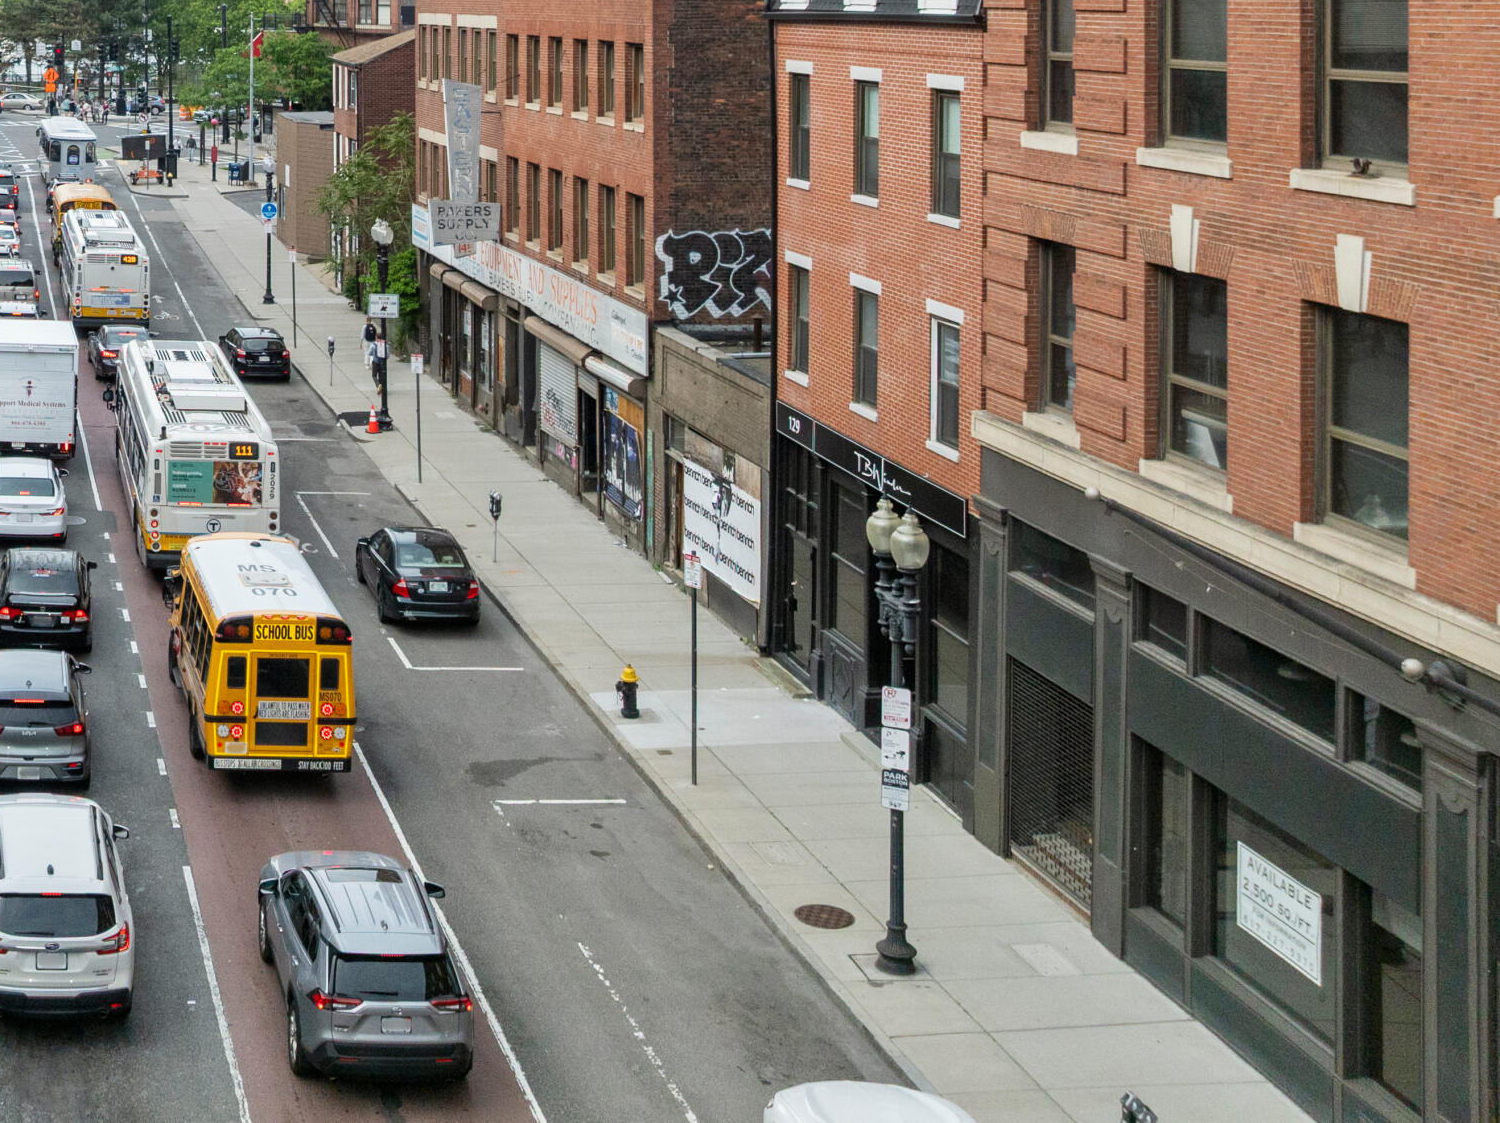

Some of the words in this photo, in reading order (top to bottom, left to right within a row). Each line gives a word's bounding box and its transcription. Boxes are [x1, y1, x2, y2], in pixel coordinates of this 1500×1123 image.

[437, 218, 491, 230] SUPPLY
[529, 263, 545, 295] AND
[550, 274, 597, 325] SUPPLIES
[18, 400, 41, 408] Medical
[42, 401, 66, 409] Systems
[788, 415, 800, 434] 129
[235, 445, 253, 456] 111
[237, 564, 277, 573] MS
[251, 588, 298, 597] 070
[256, 624, 292, 639] SCHOOL
[295, 625, 314, 640] BUS
[319, 692, 342, 701] MS070
[288, 702, 298, 710] PASS
[298, 702, 309, 710] WHEN
[267, 710, 280, 718] LIGHTS
[281, 710, 289, 718] ARE
[290, 710, 310, 719] FLASHING
[298, 761, 309, 770] STAY
[310, 761, 322, 770] BACK
[333, 762, 344, 770] FEET
[883, 771, 908, 782] PARK
[883, 778, 908, 786] BOSTON
[1247, 856, 1312, 910] AVAILABLE
